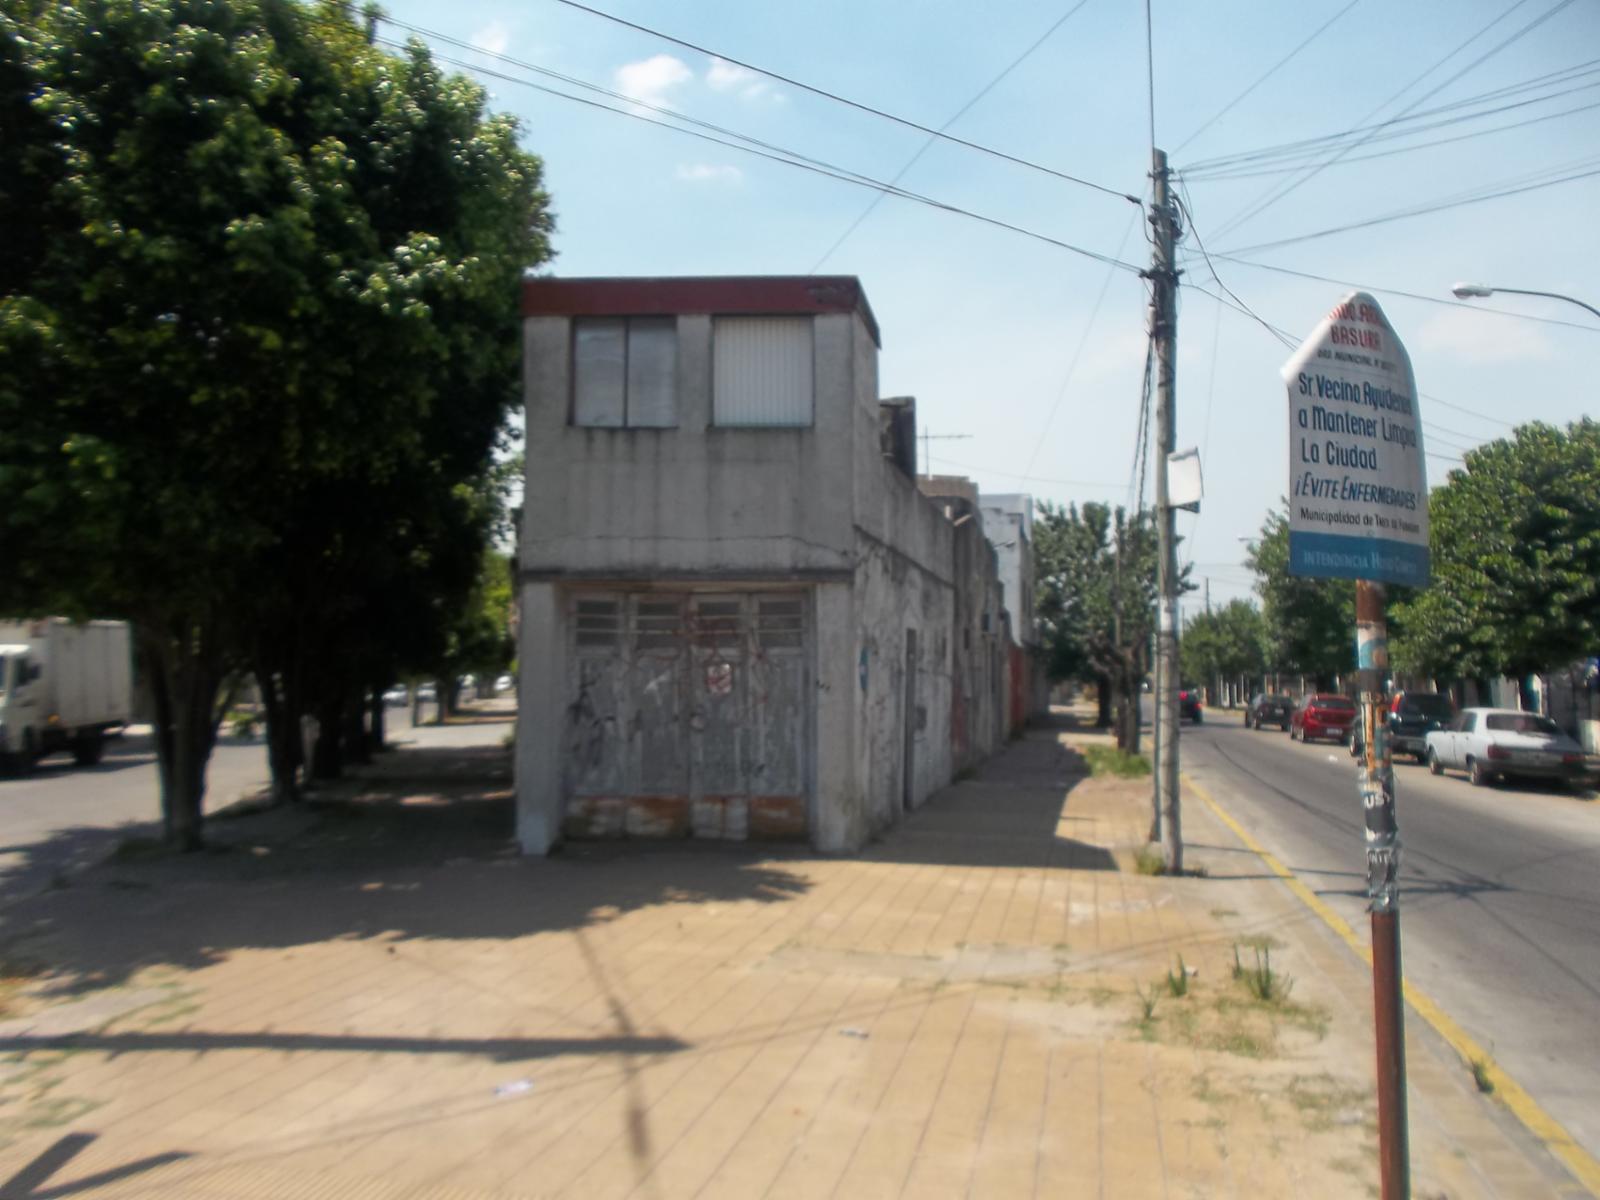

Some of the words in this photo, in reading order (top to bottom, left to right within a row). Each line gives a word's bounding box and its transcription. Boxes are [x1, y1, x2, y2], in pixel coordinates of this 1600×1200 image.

[1298, 408, 1307, 428] a
[1312, 405, 1377, 438] Mantener
[1301, 437, 1320, 463] La
[1299, 506, 1361, 526] Municipalidad
[1363, 513, 1374, 526] de
